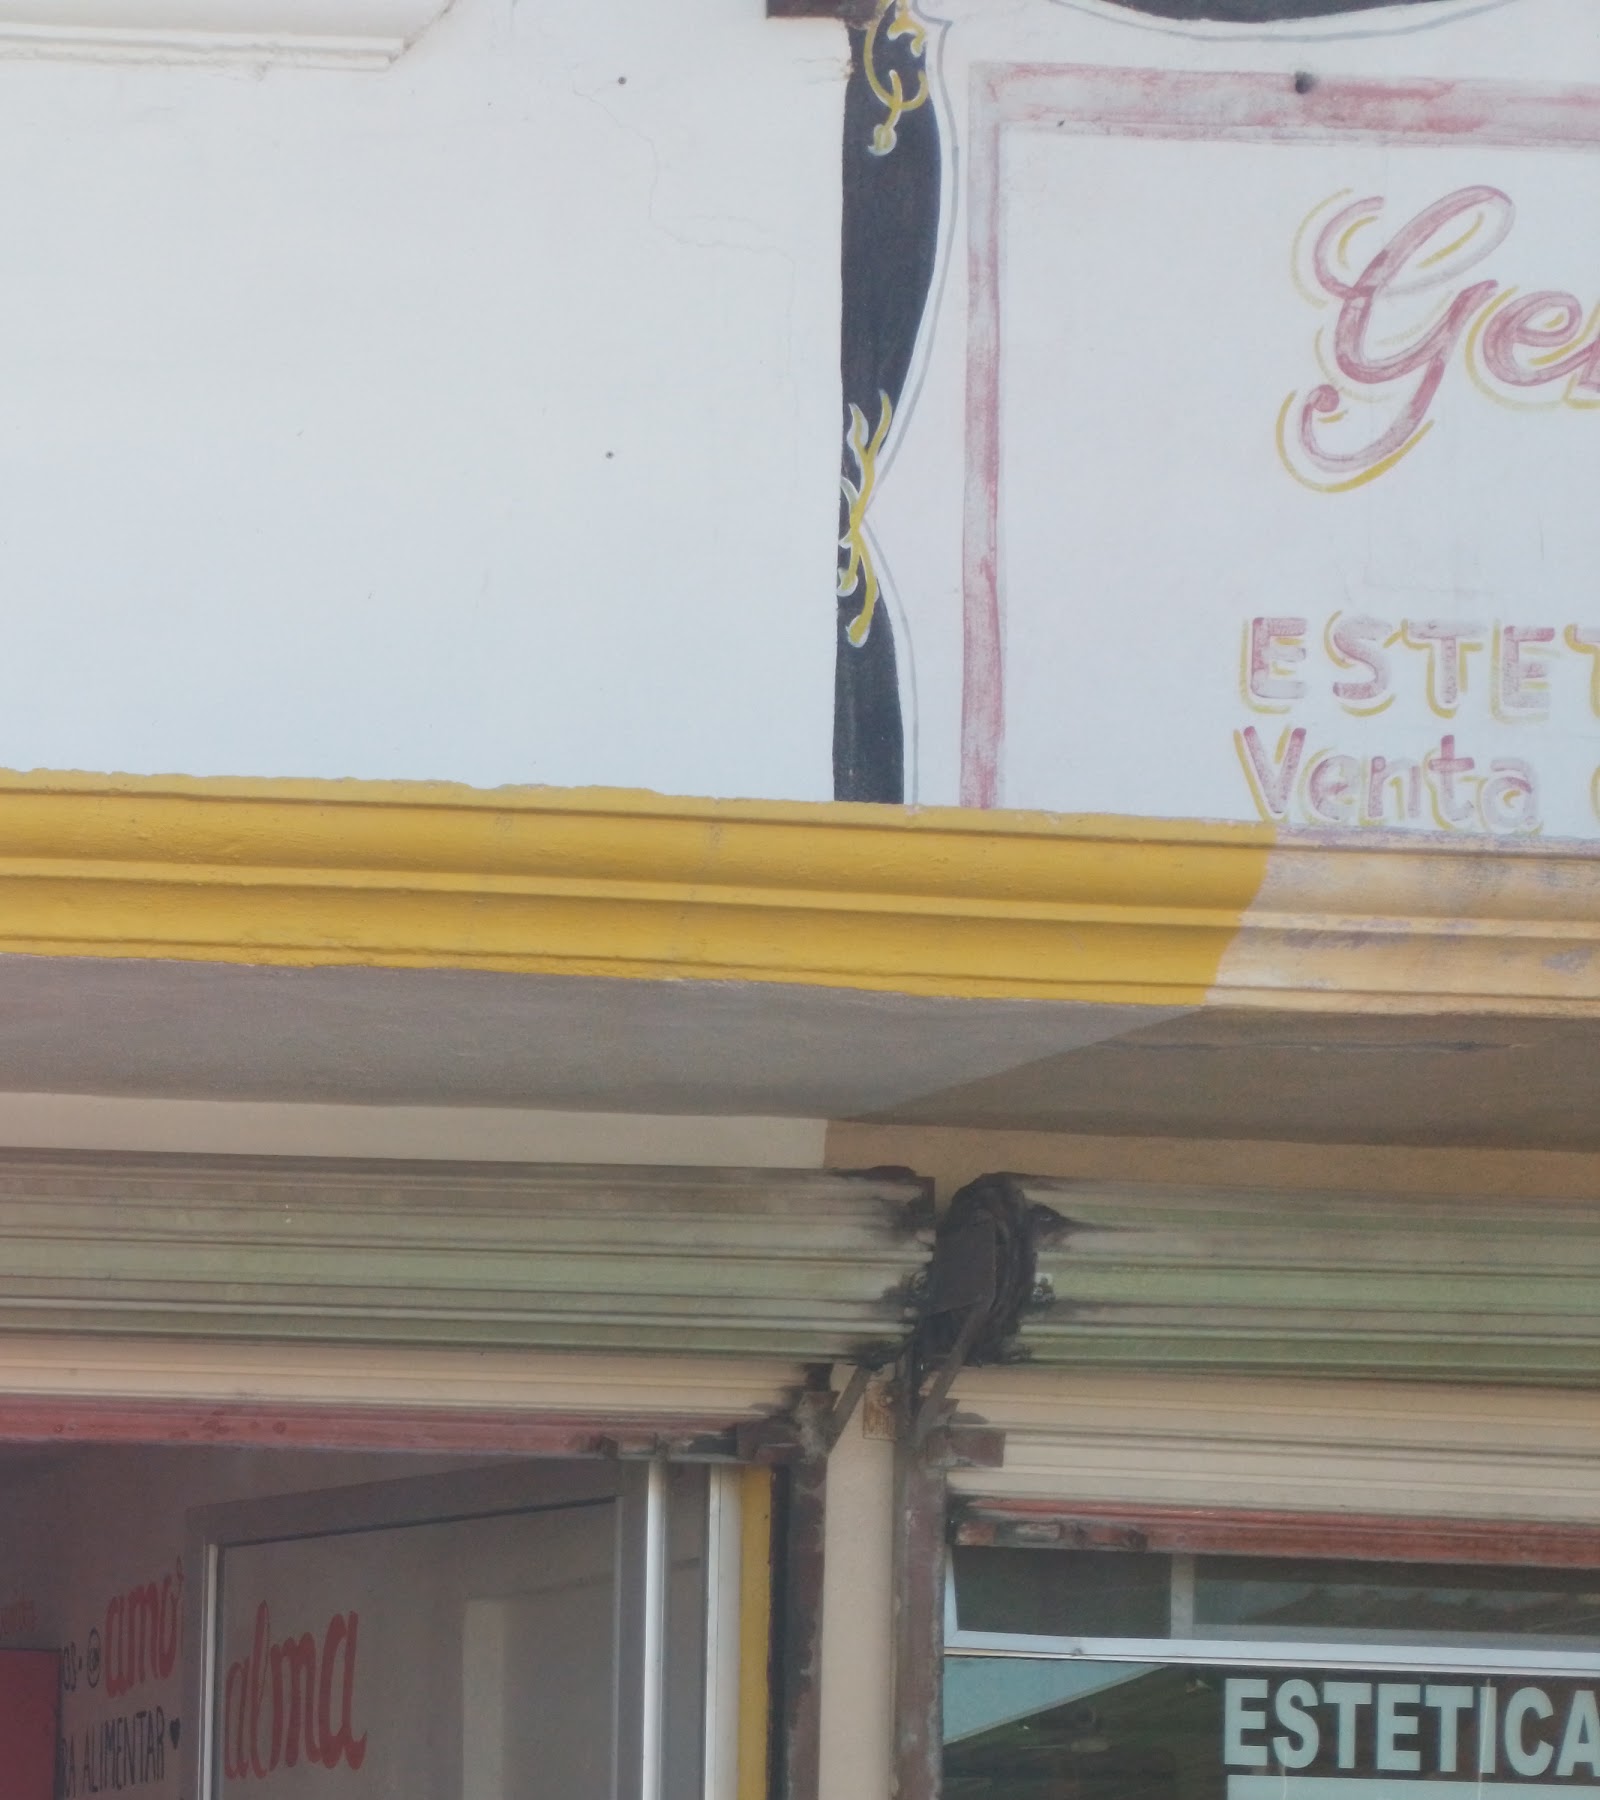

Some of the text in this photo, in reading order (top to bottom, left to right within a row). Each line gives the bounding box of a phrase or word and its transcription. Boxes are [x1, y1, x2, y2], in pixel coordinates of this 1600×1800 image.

[1278, 184, 1600, 493] Ge
[1234, 726, 1544, 836] Venta
[223, 1601, 368, 1781] alma
[1223, 1678, 1600, 1778] ESTETICA
[84, 1706, 166, 1795] ALIMENTAR
